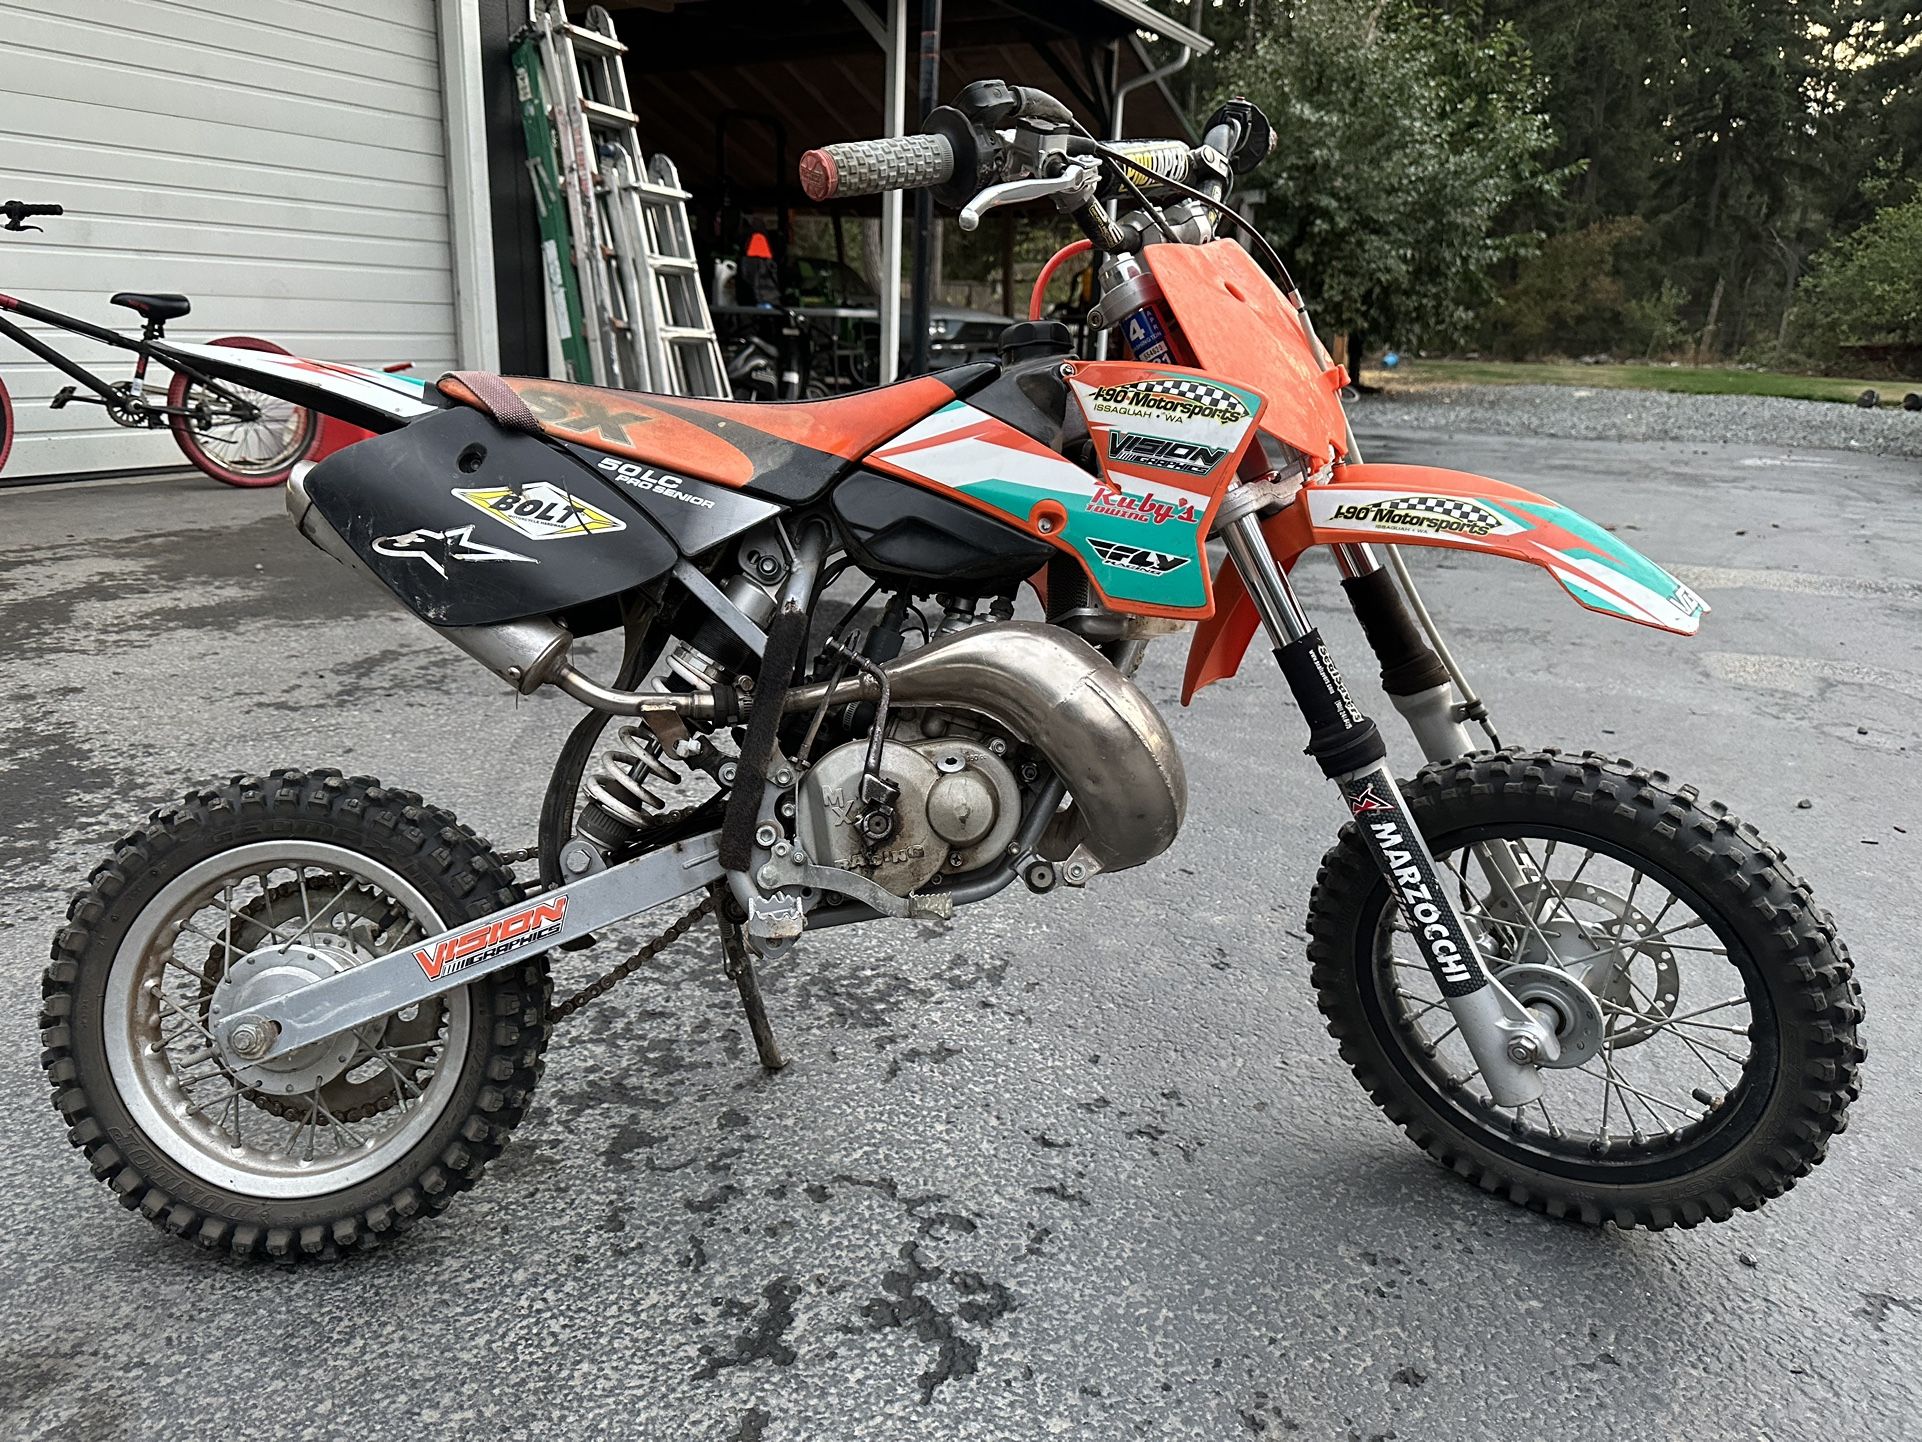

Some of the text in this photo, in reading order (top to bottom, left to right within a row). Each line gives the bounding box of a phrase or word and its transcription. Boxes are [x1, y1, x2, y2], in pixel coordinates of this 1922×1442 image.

[1129, 318, 1146, 341] 4
[519, 389, 656, 448] SX
[1089, 386, 1242, 424] I-90 Motorsports
[1094, 404, 1183, 424] ISSAQUAH WA
[1110, 431, 1229, 468] VISION
[1136, 456, 1211, 476] GRAPHICS
[597, 457, 683, 490] 50 LC
[614, 474, 716, 509] PRO SENIOR
[1092, 481, 1198, 525] Ruby's
[488, 495, 586, 524] BOLT
[1086, 504, 1149, 523] TOWING
[1329, 504, 1490, 536] I-90 Motorsports
[1086, 537, 1191, 571] FLY
[1103, 561, 1162, 576] RACING
[1370, 821, 1472, 983] MARZOCCHI
[413, 896, 569, 980] VISION
[469, 923, 561, 964] GRAPHICS
[107, 1126, 256, 1222] DUNLOP
